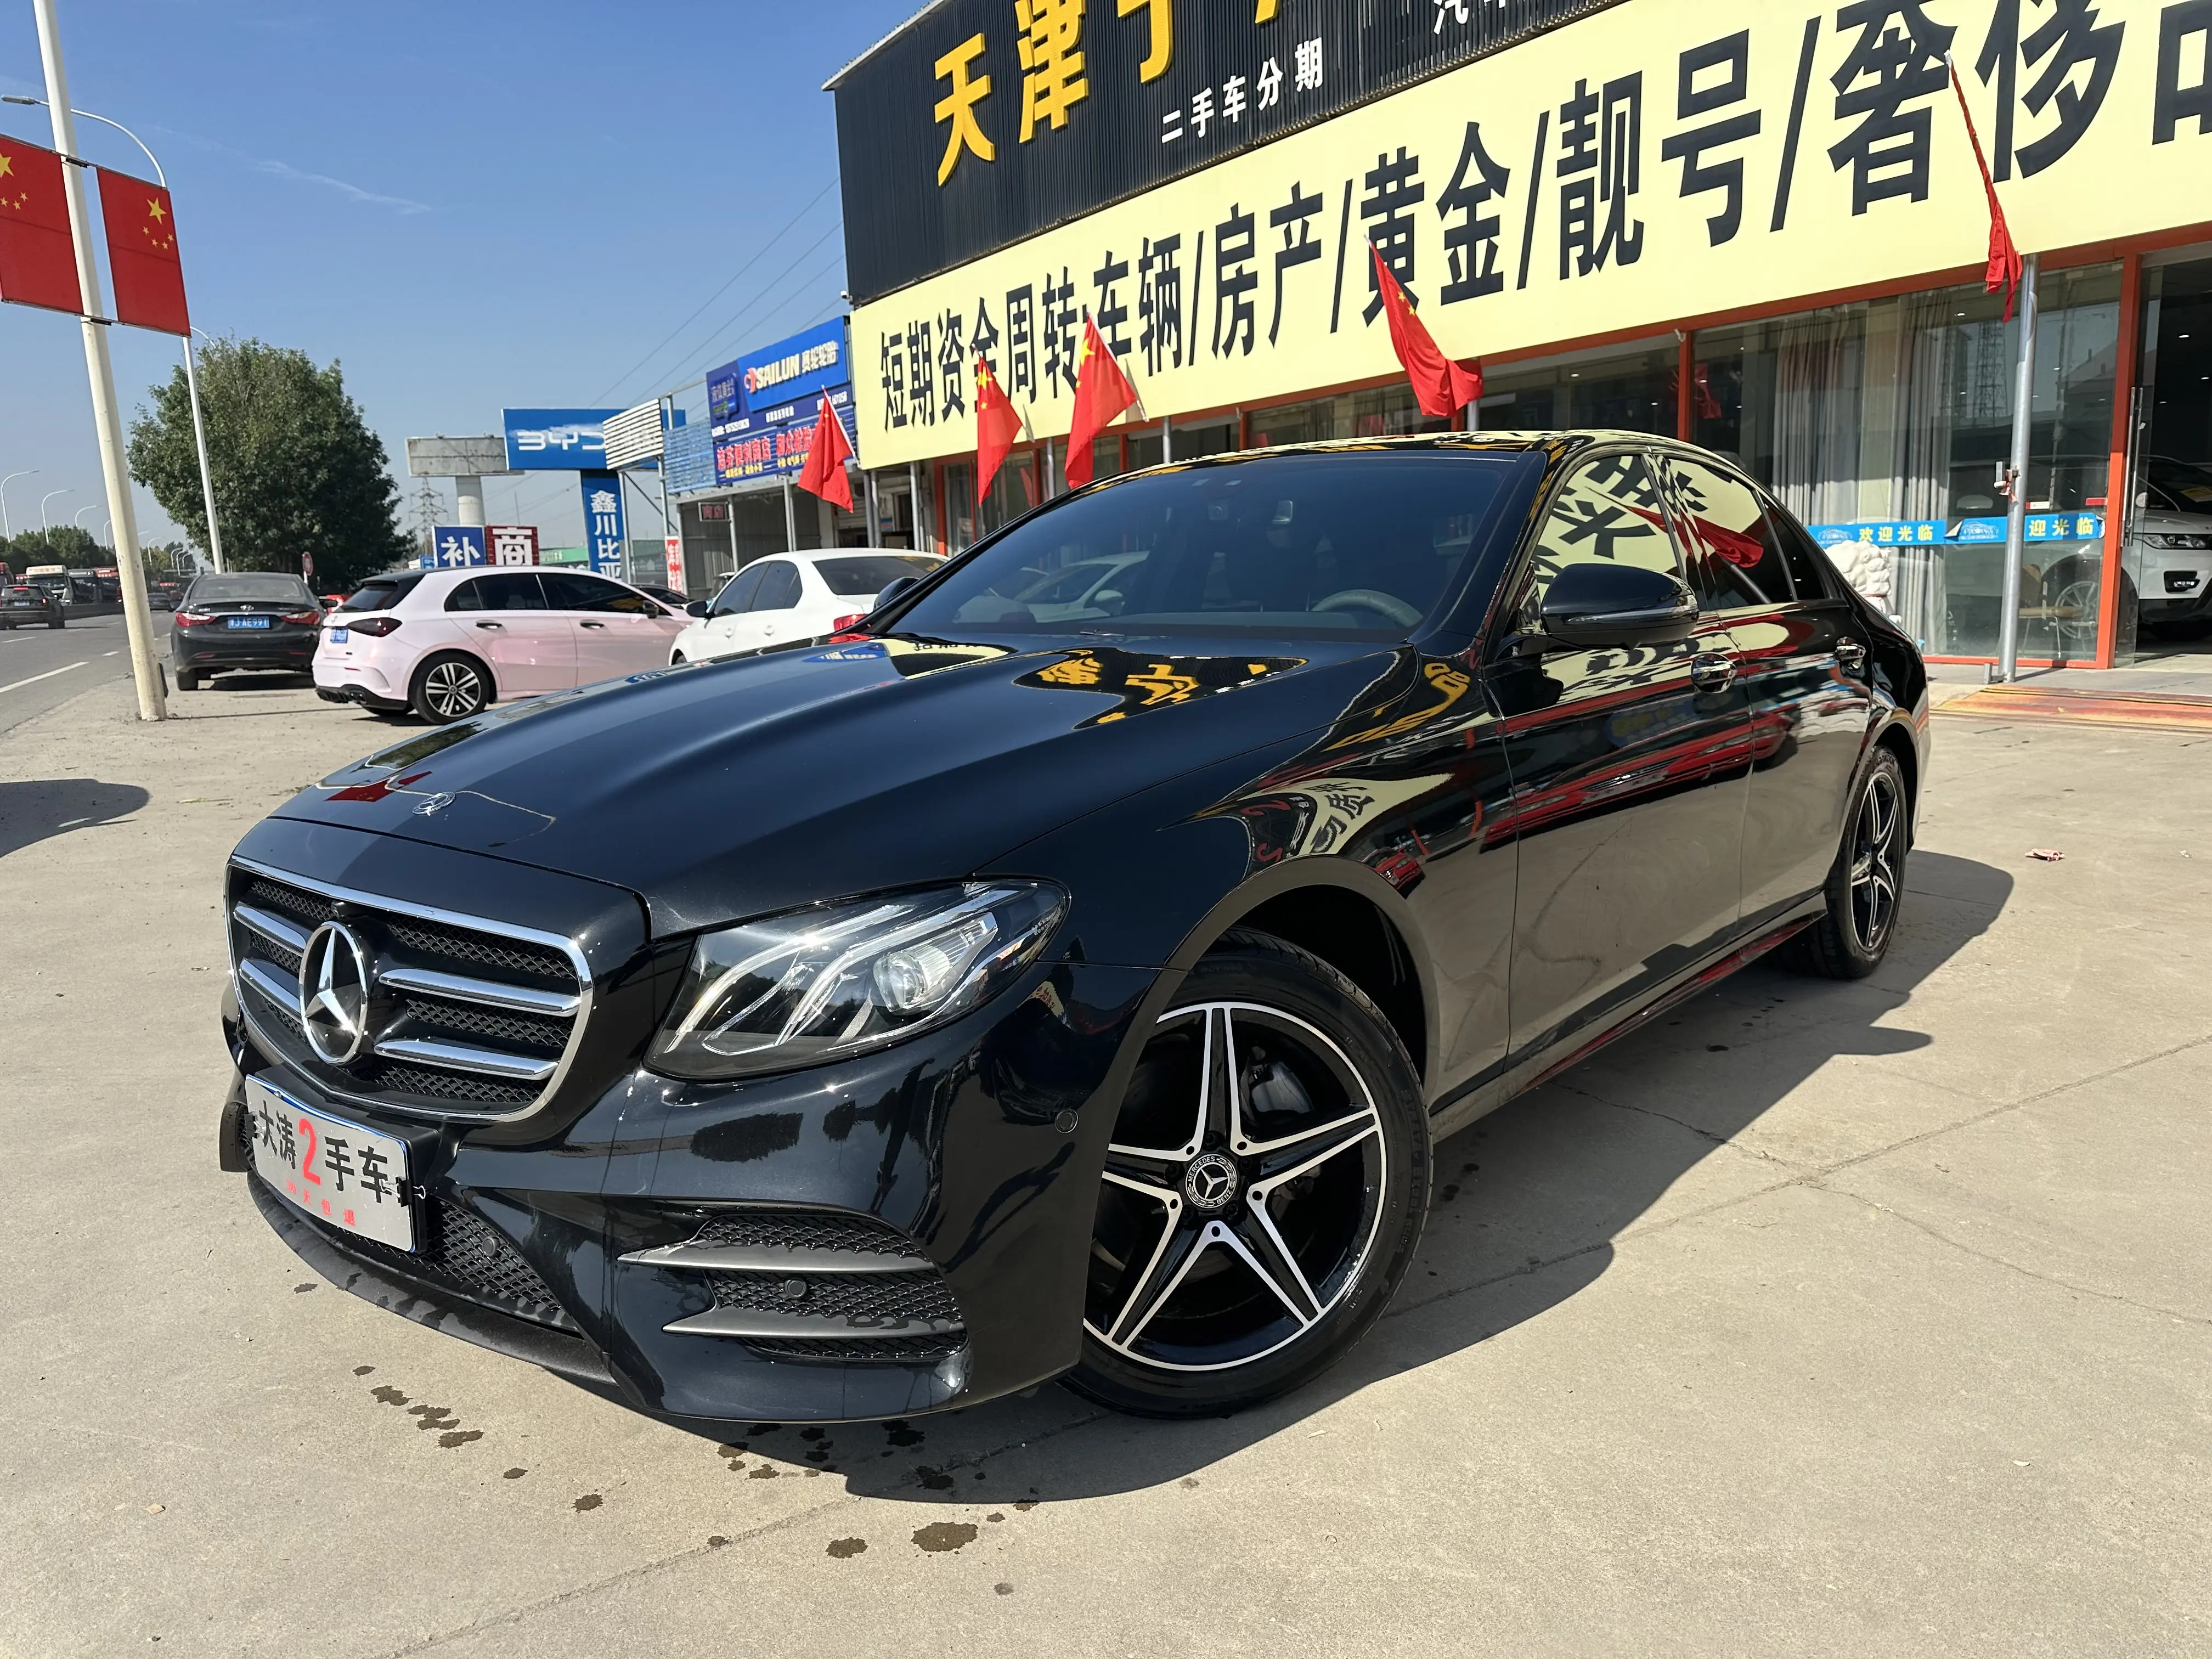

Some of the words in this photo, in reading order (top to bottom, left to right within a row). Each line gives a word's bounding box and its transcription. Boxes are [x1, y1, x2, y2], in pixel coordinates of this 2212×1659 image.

[1161, 38, 1323, 144] 二手车分期
[755, 353, 800, 389] SAILUN
[517, 432, 605, 450] BYD
[492, 527, 532, 566] 商
[1859, 524, 1934, 542] 欢迎光临
[441, 536, 481, 566] 补
[259, 1100, 392, 1203] 大涛2手车
[1188, 1156, 1215, 1182] MERCEDES
[1216, 1189, 1232, 1204] BENZ
